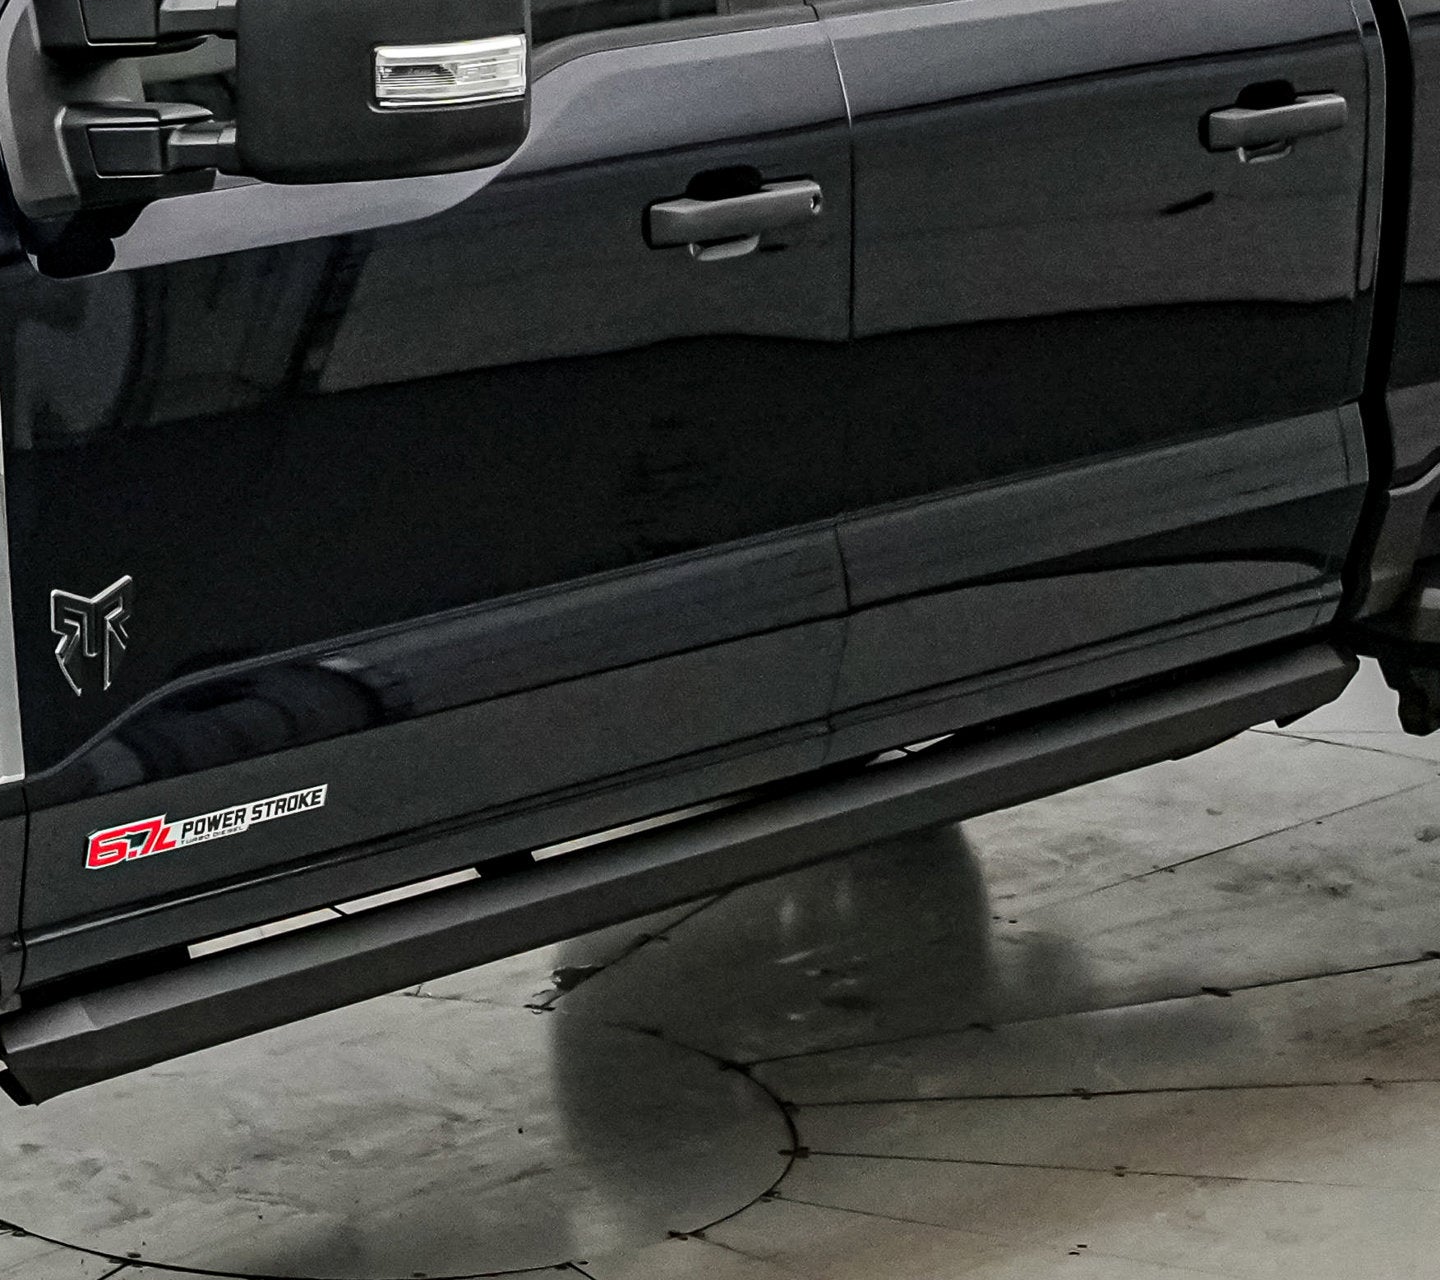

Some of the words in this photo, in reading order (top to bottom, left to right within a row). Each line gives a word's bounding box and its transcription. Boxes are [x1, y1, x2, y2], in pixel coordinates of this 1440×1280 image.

[88, 819, 176, 868] 6.7L
[181, 807, 247, 839] POWER
[251, 788, 323, 821] STROKE
